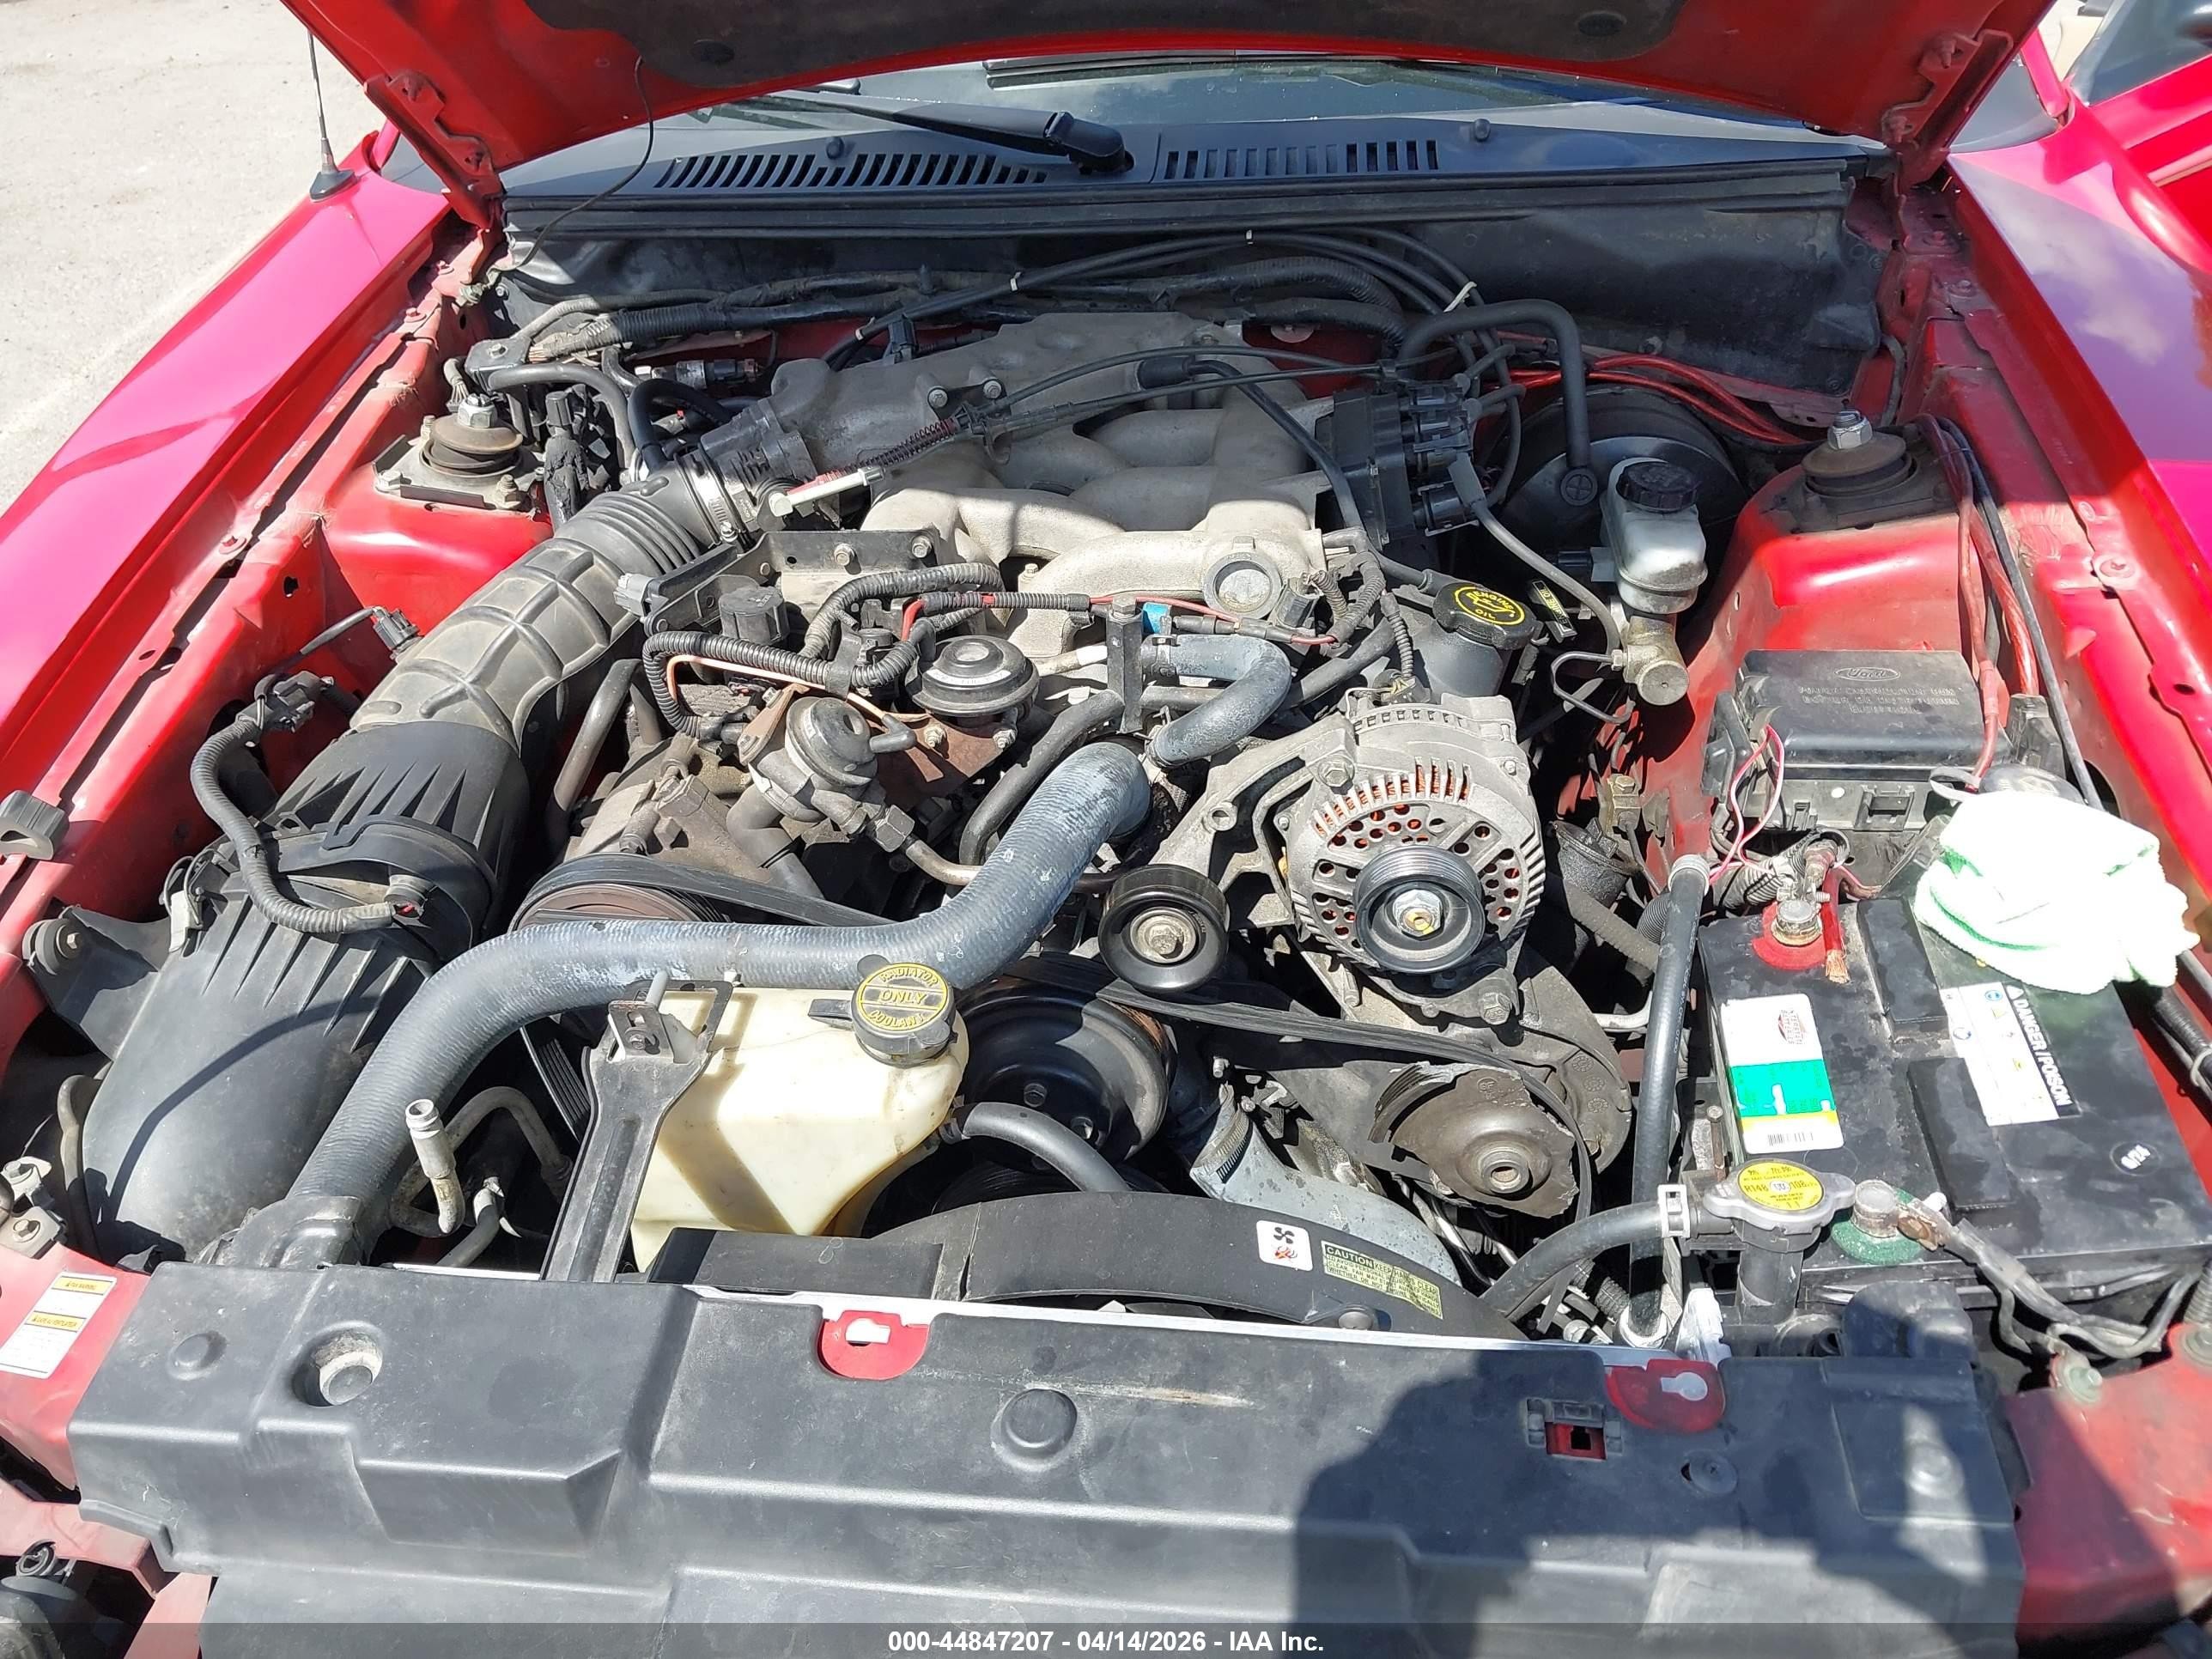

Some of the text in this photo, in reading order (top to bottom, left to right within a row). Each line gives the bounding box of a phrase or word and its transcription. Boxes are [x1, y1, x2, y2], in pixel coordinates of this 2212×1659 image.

[1473, 591, 1514, 610] ENGINE
[1475, 609, 1497, 619] OIL
[880, 968, 939, 987] RADIATOR
[880, 990, 927, 1005] ONLY
[870, 1010, 925, 1027] COOLANT
[2013, 999, 2048, 1051] DANGER
[2038, 1057, 2074, 1106] POISON
[1327, 1246, 1373, 1267] CAUTION
[1375, 1262, 1392, 1273] KEEP
